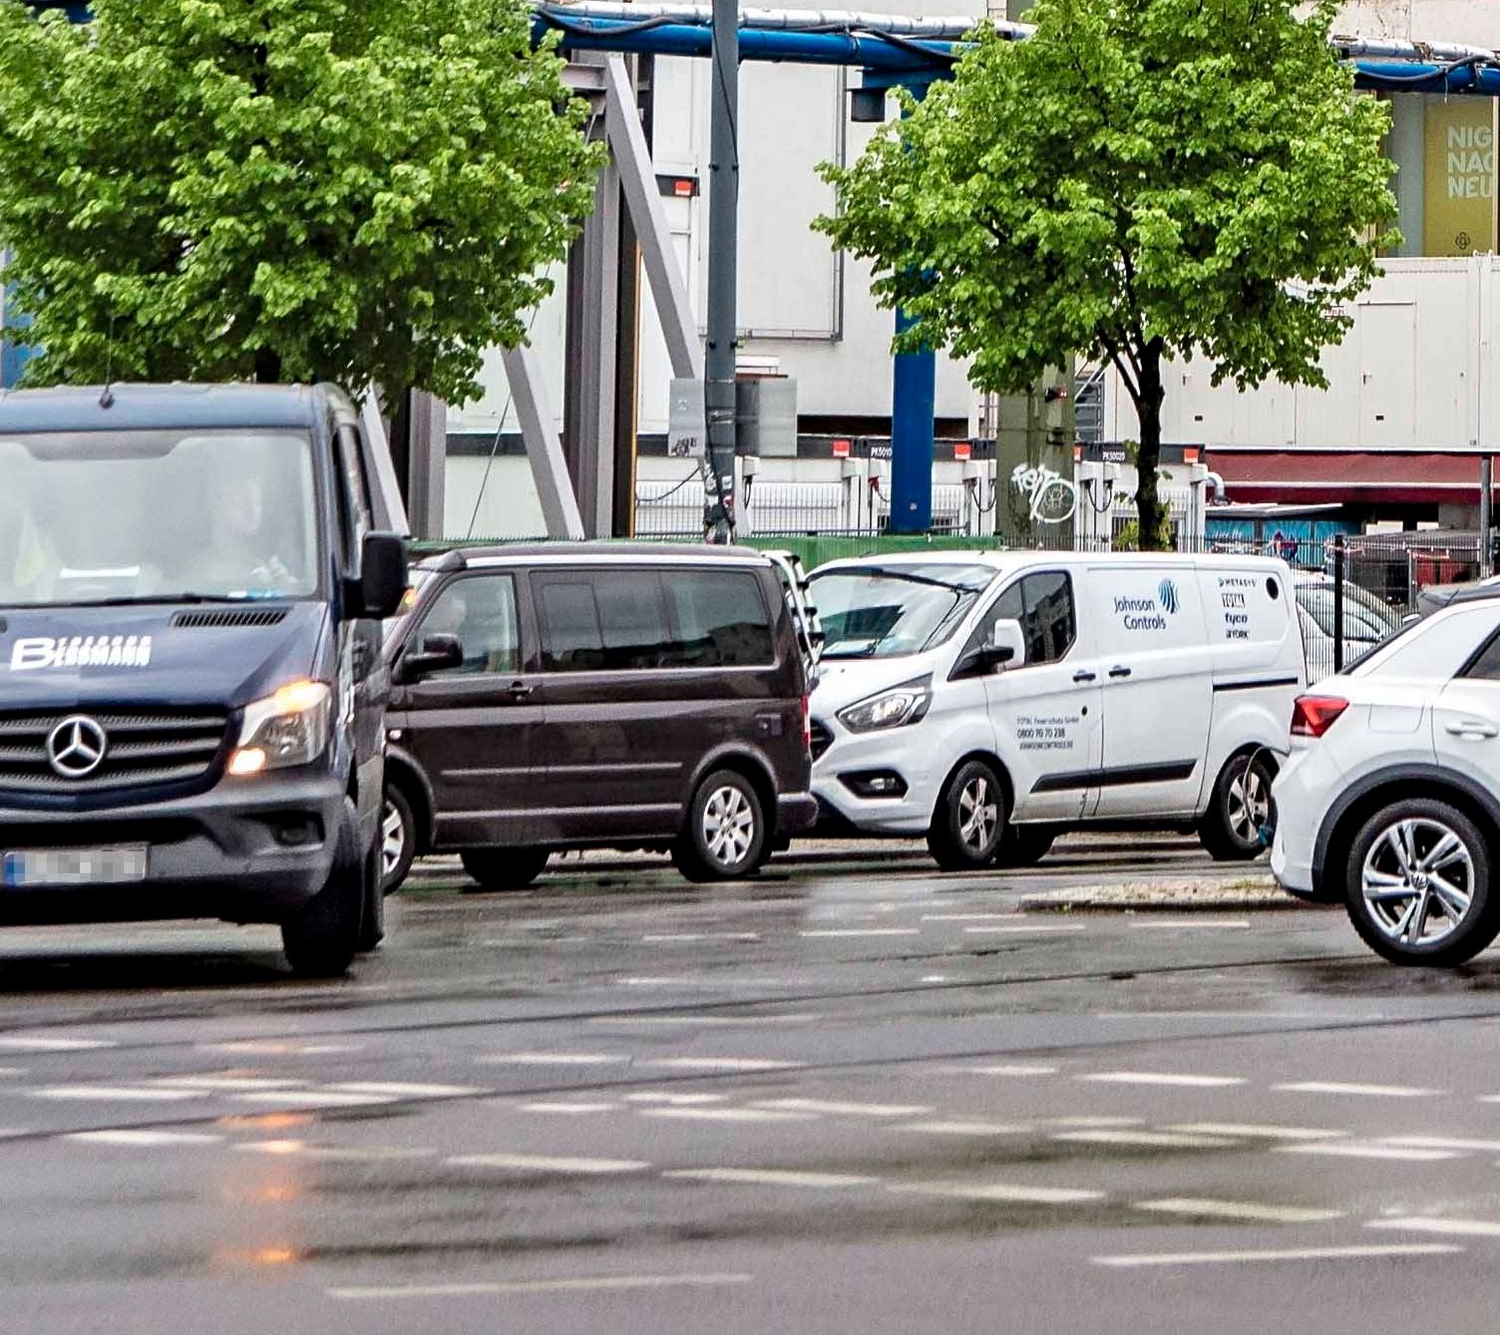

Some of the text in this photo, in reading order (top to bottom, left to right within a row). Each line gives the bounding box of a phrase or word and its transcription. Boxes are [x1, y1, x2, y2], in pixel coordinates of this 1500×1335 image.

[1113, 596, 1156, 614] Johnson
[1123, 613, 1167, 630] Controls
[1224, 612, 1249, 627] tyco
[1016, 728, 1034, 739] 0800
